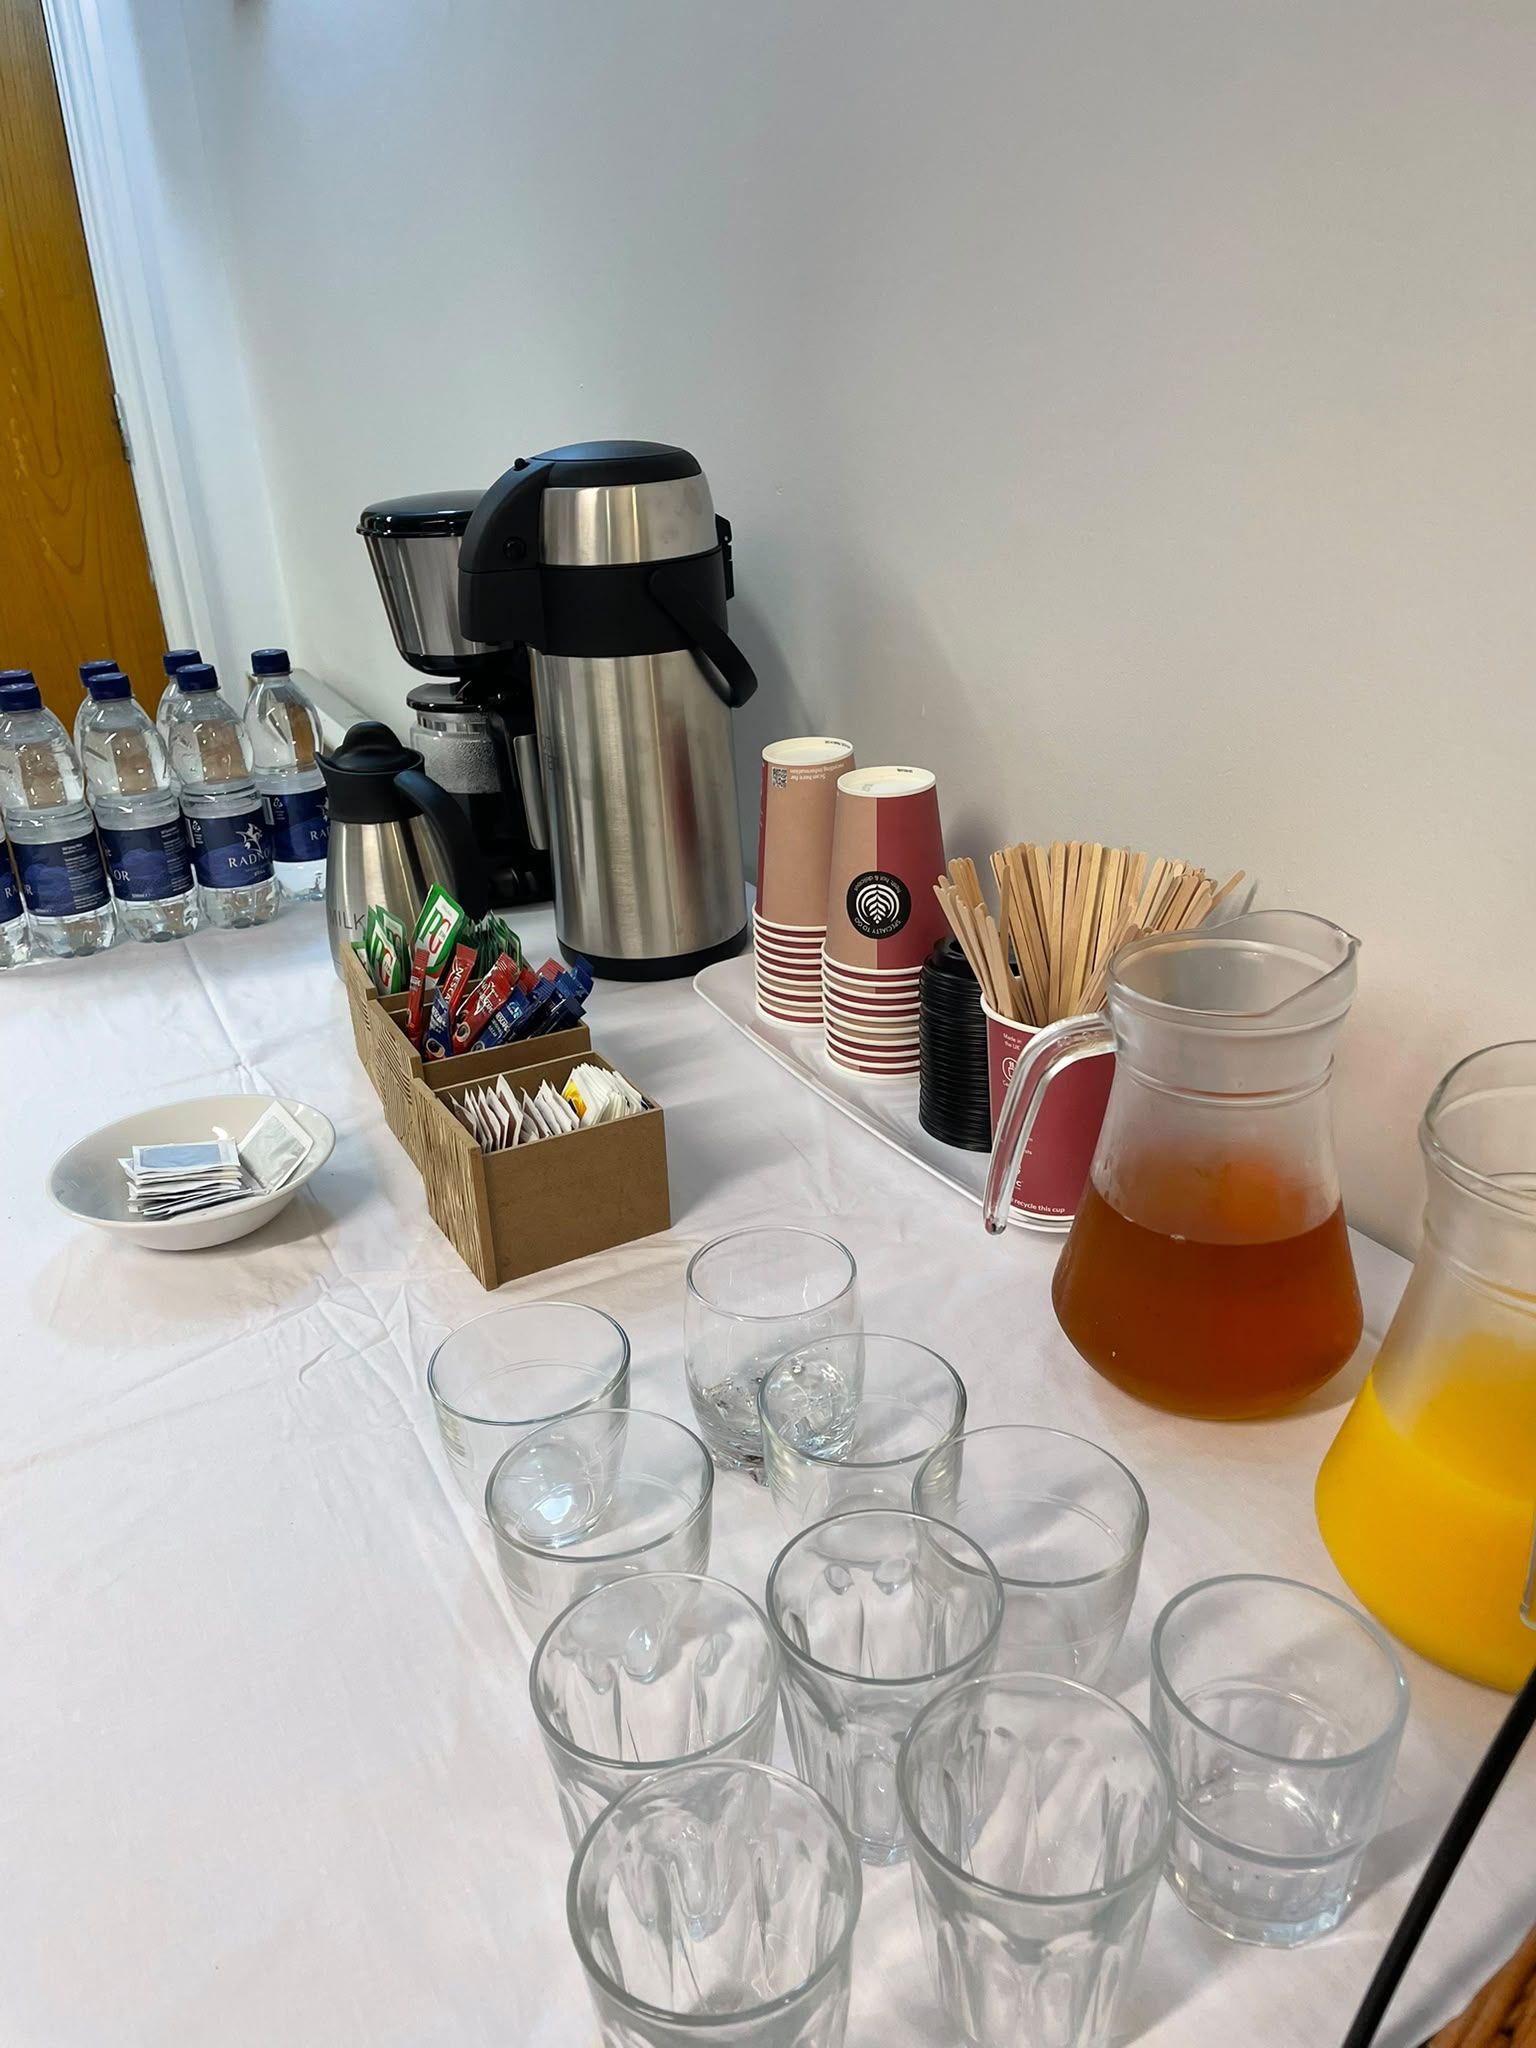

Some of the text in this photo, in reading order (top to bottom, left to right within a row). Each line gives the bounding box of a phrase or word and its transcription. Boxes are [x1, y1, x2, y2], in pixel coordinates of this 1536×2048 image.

[854, 917, 901, 935] SPECIALTY TO GO
[1014, 1199, 1037, 1210] recycle
[1038, 1204, 1051, 1212] this
